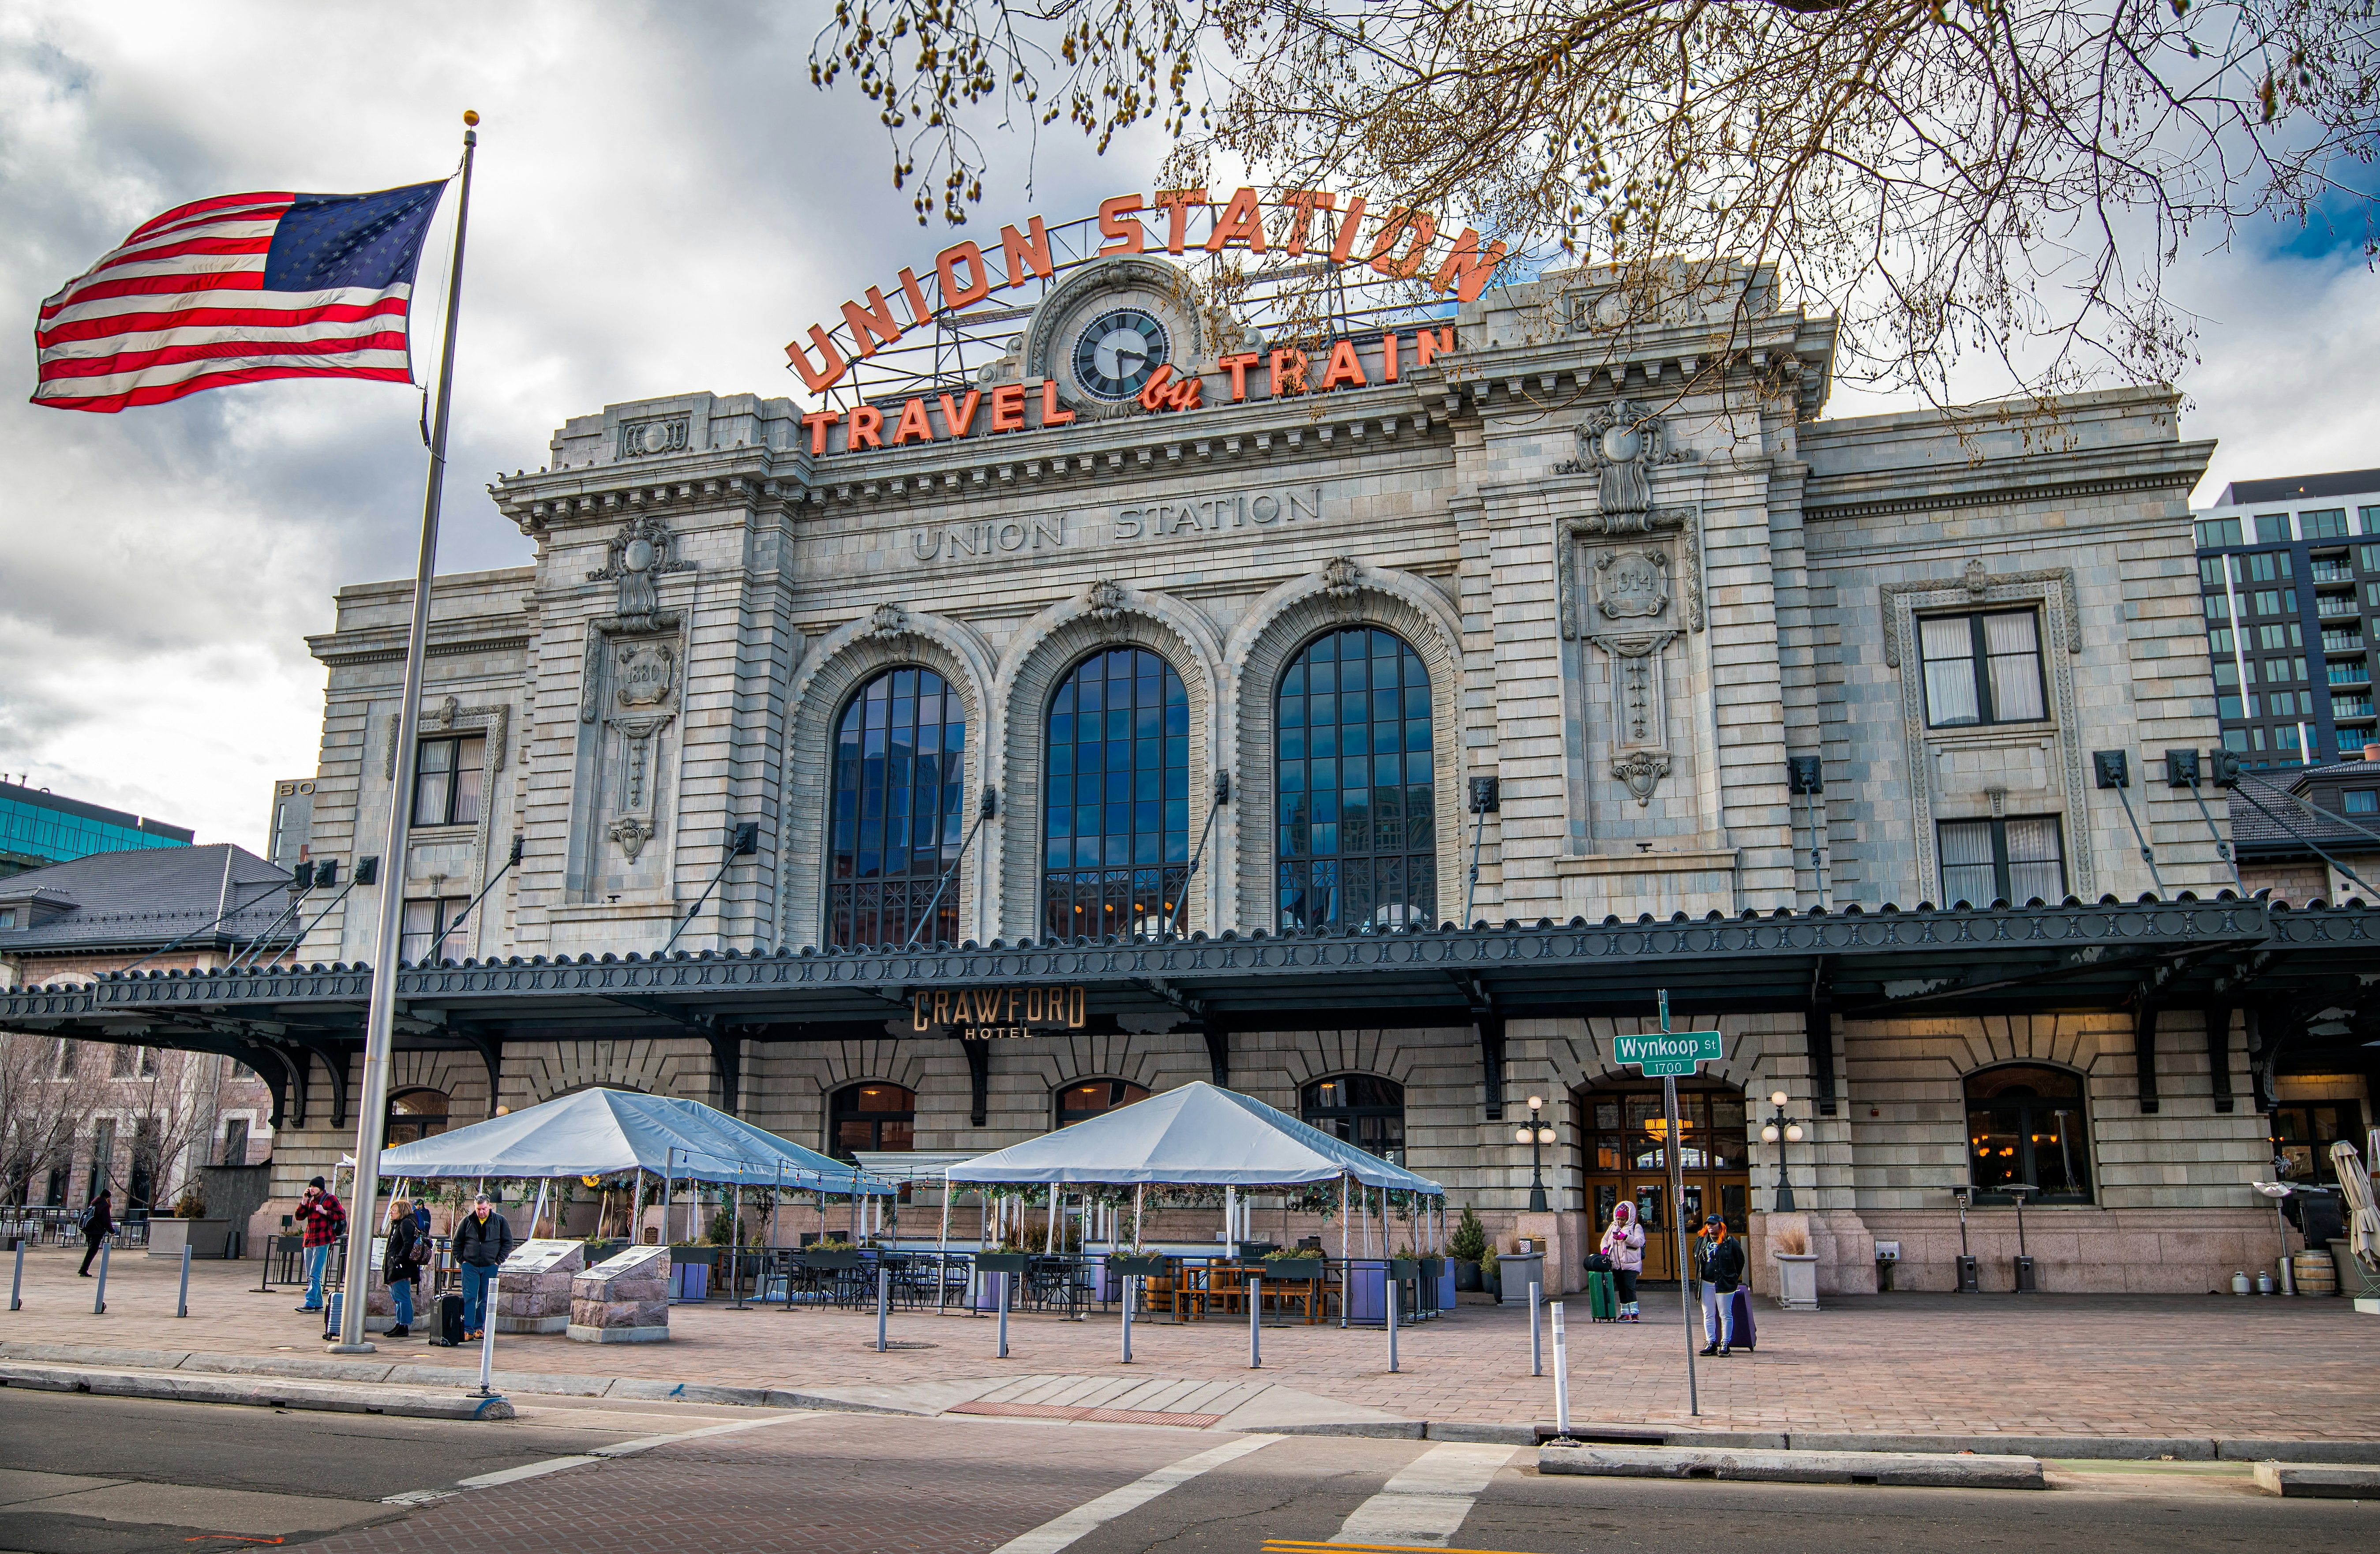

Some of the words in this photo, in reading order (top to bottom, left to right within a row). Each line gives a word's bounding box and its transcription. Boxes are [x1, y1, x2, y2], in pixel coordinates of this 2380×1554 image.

[784, 215, 1054, 393] UNION
[1099, 187, 1507, 303] STATION
[801, 379, 1076, 454] TRAVEL
[1135, 363, 1203, 412] by
[1218, 326, 1454, 403] TRAIN
[912, 515, 1064, 560] UNION
[1114, 487, 1320, 539] STATION
[1608, 571, 1653, 593] 1914
[627, 664, 659, 683] 1880
[913, 986, 1086, 1031] CRAWFORD
[965, 1027, 1032, 1040] HOTEL
[1620, 1037, 1698, 1059] Wynkoop
[1705, 1040, 1717, 1049] St
[1655, 1063, 1682, 1073] 1700
